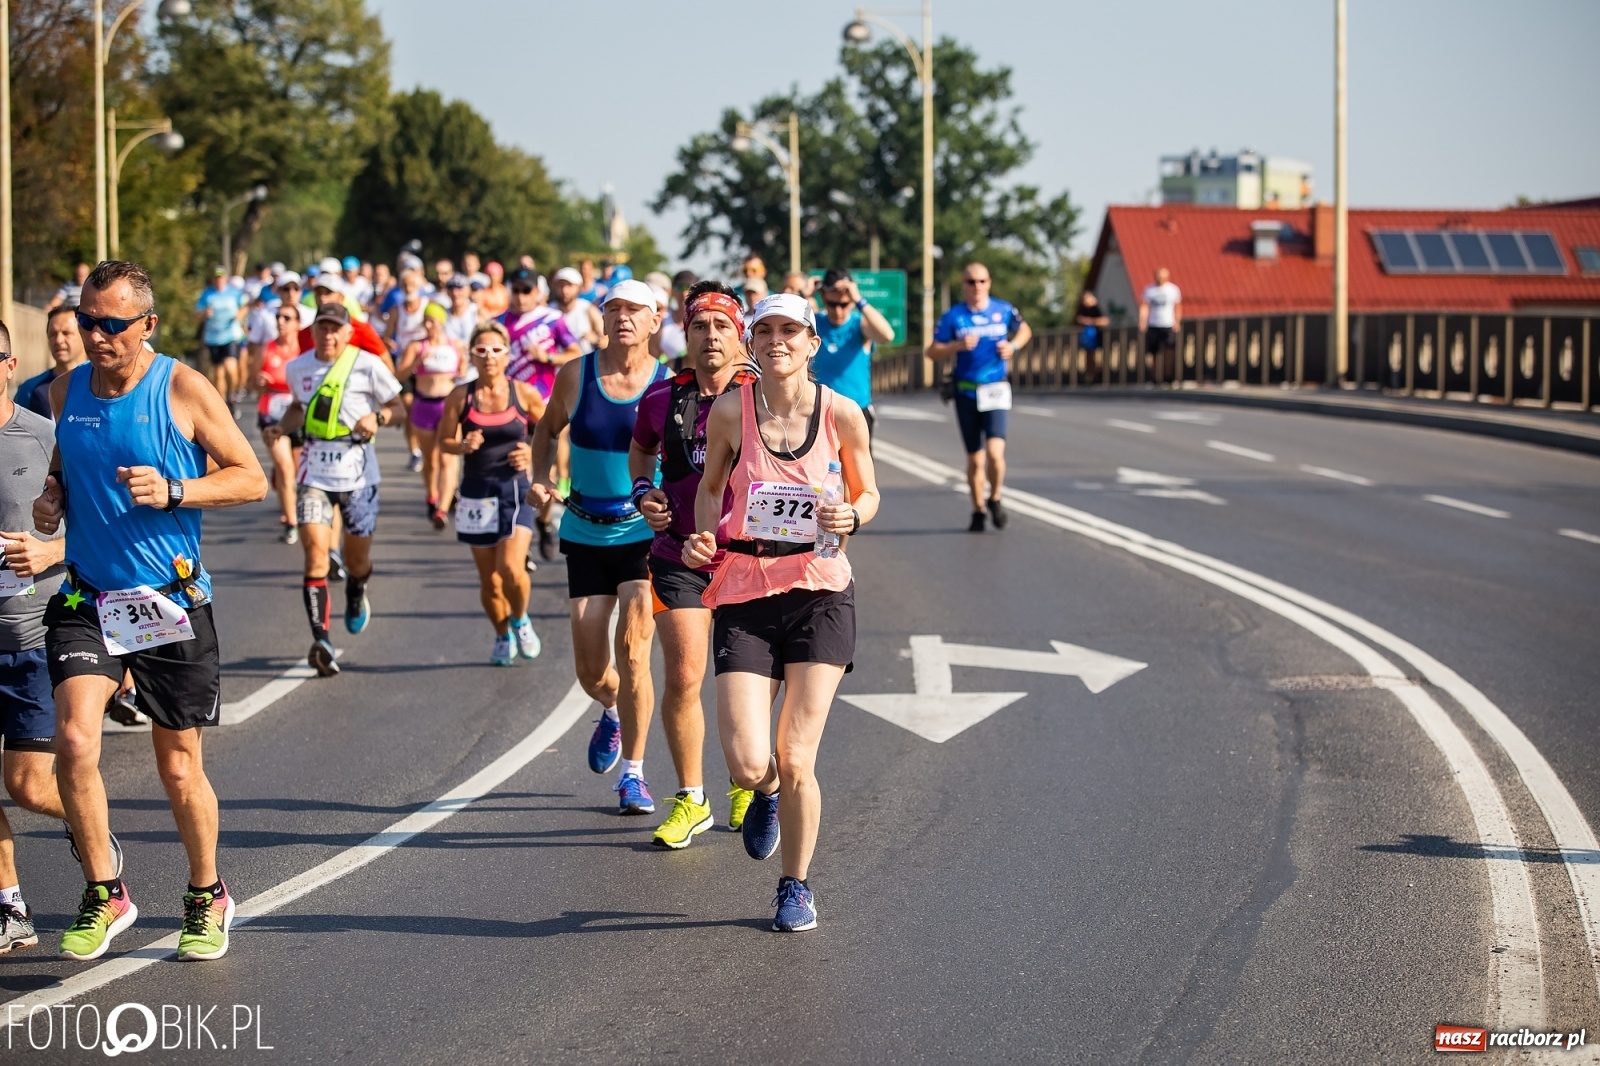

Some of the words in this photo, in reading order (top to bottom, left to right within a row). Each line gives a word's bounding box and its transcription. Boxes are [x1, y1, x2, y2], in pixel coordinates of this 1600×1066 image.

[320, 451, 342, 463] 214
[12, 466, 29, 476] 4F
[772, 498, 815, 520] 372
[126, 601, 164, 625] 341
